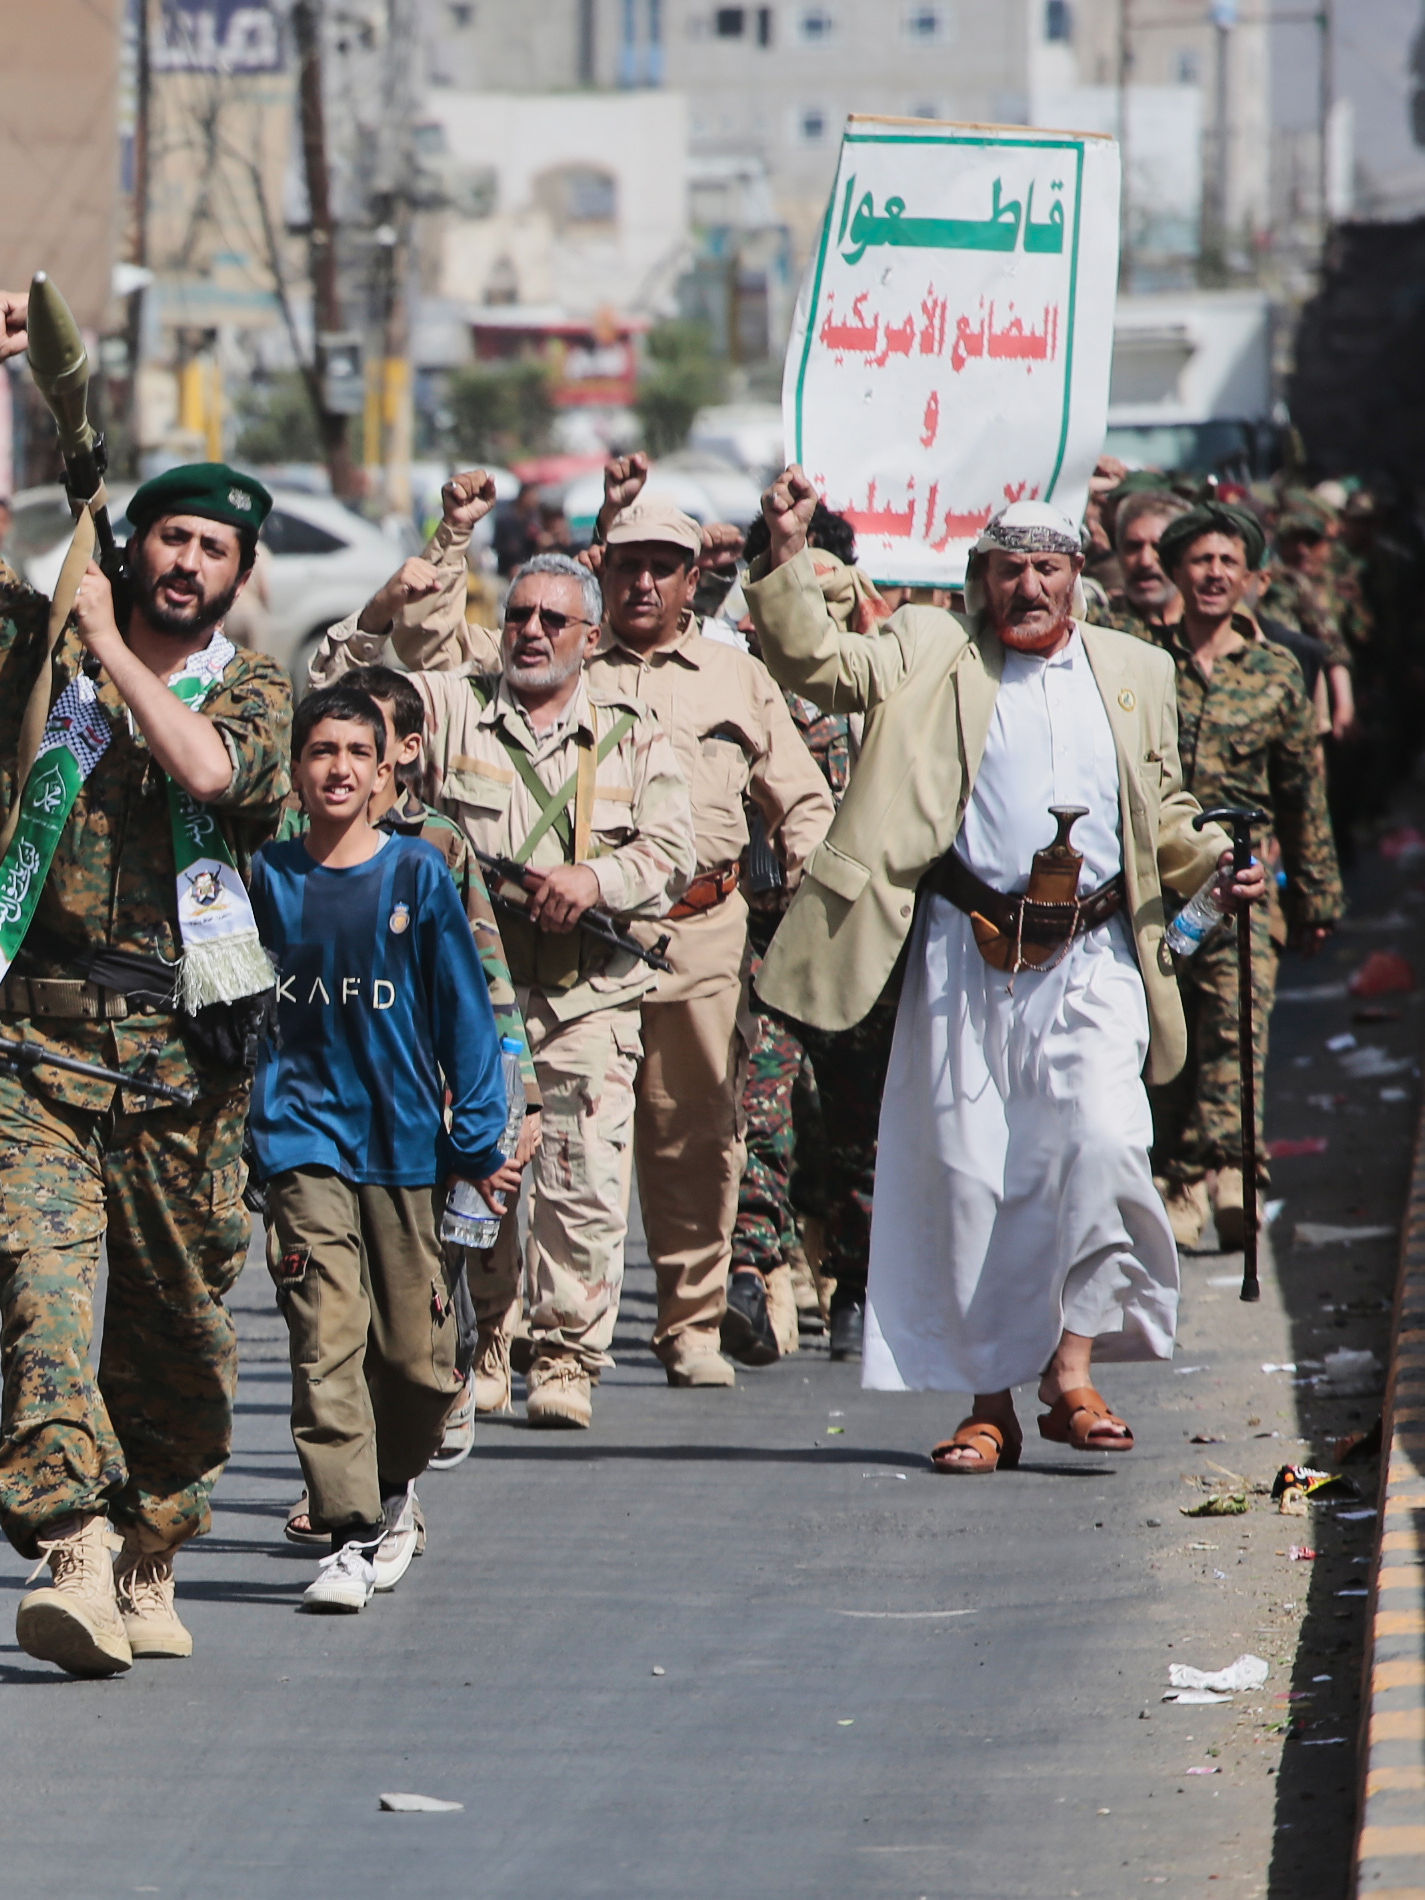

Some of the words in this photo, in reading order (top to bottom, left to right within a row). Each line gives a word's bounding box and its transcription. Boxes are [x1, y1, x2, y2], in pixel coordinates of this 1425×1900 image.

[837, 173, 1065, 265] قاطعوا
[951, 294, 1059, 374] البضائع
[920, 390, 940, 449] و
[275, 974, 395, 1010] KAFD
